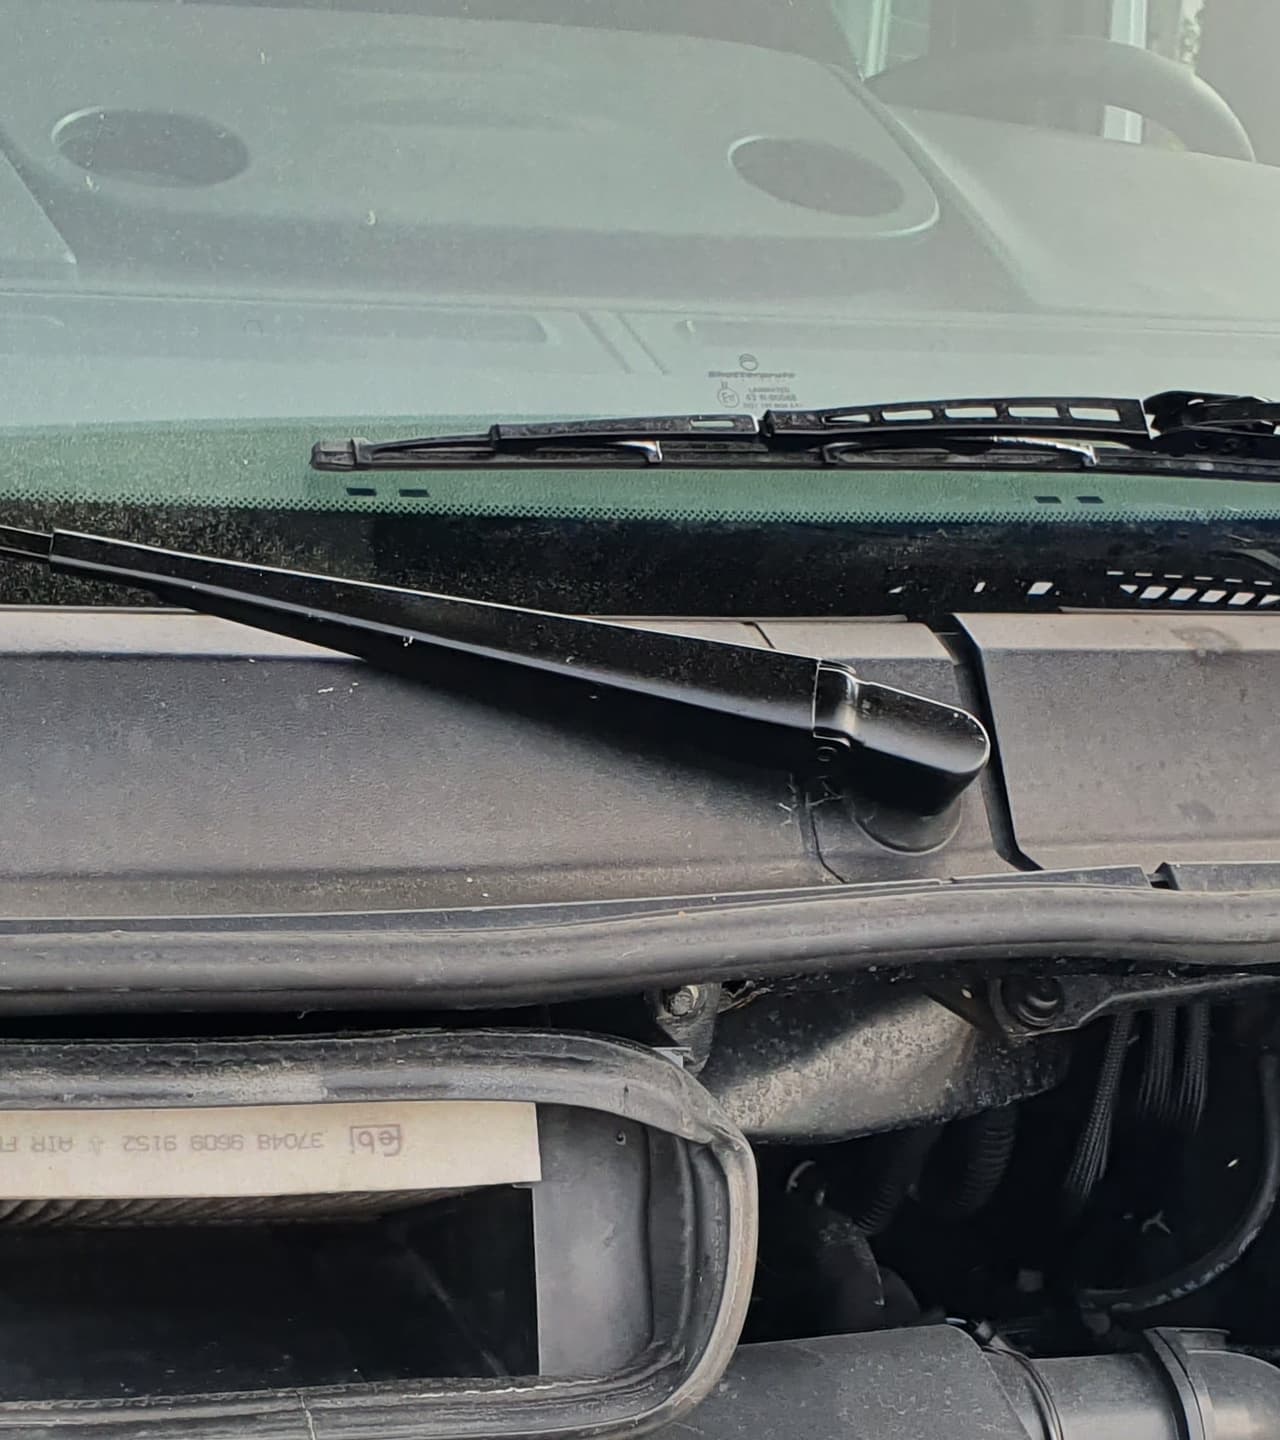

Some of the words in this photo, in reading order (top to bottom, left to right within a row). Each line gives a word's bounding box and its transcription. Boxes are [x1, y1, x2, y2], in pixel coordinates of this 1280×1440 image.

[30, 1135, 73, 1153] AIR
[122, 1135, 177, 1152] 9152
[190, 1134, 245, 1152] 9609
[257, 1132, 326, 1151] 37048
